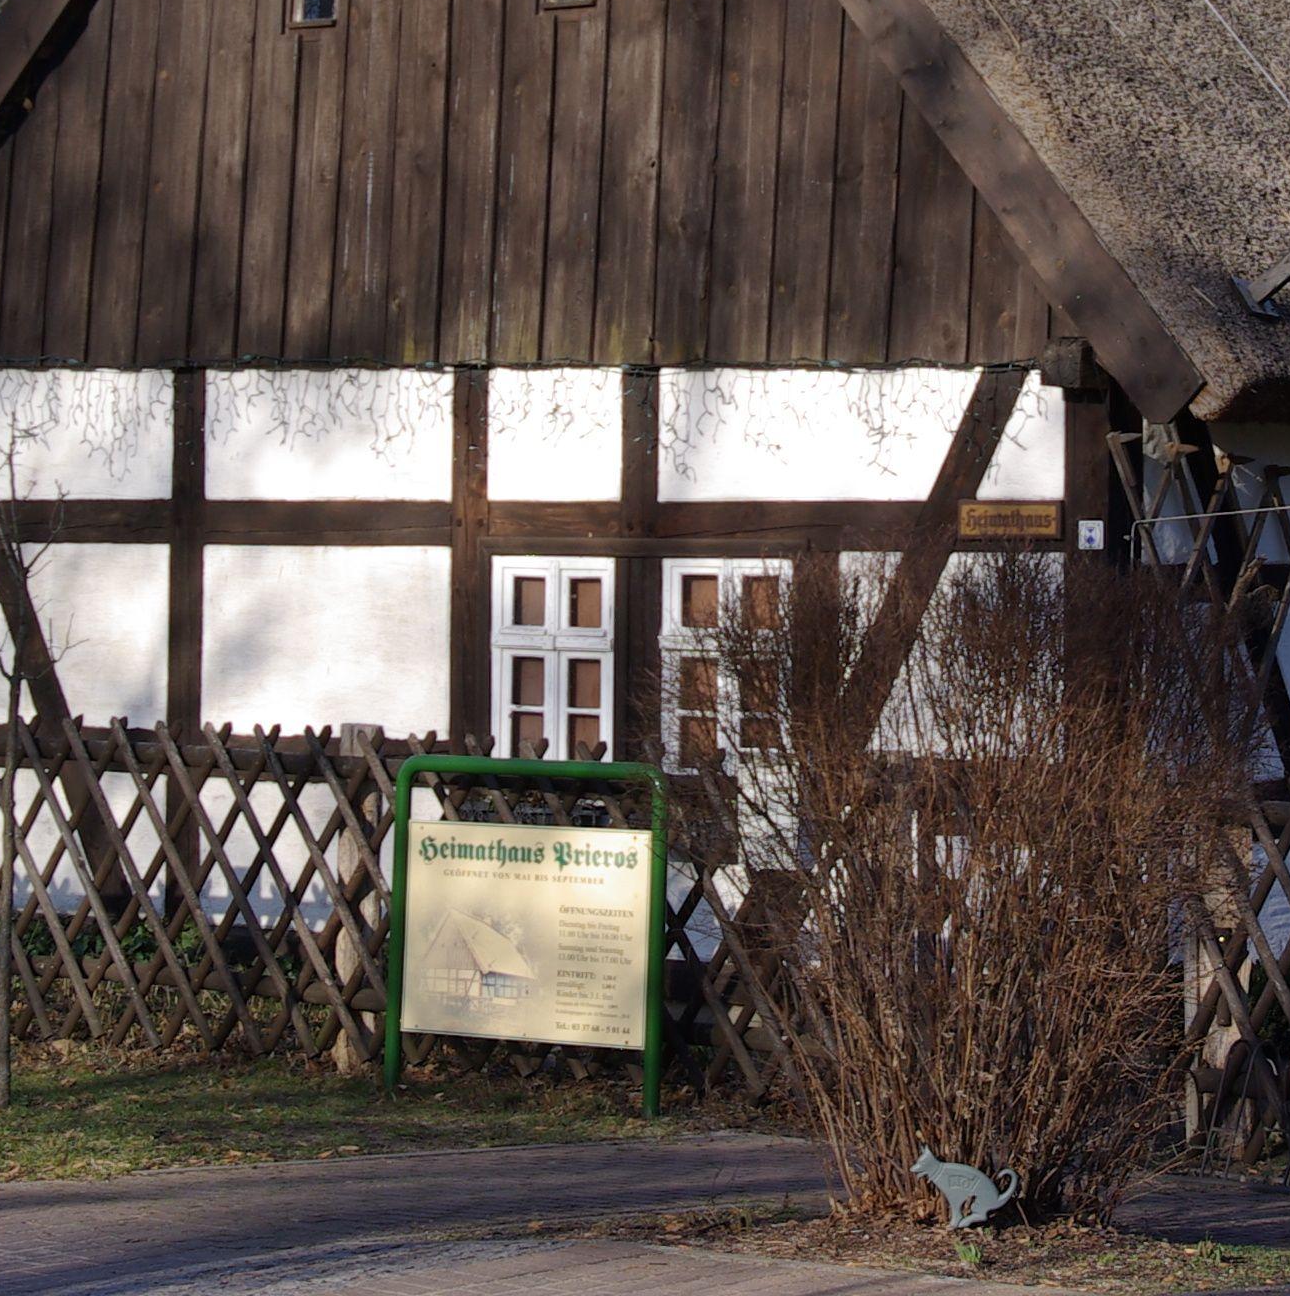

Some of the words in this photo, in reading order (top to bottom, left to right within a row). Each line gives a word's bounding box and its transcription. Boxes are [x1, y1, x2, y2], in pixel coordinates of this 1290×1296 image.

[966, 508, 1052, 532] Heimathaus
[419, 835, 545, 869] Heimathaus
[553, 841, 638, 873] Prieros
[443, 868, 488, 878] GEÖFFNET
[492, 871, 510, 879] VON
[513, 872, 531, 881] MAI
[534, 873, 548, 881] BIS
[552, 874, 605, 885] SEPTEMBER
[558, 904, 634, 918] ÖFFNUNGSZEITEN
